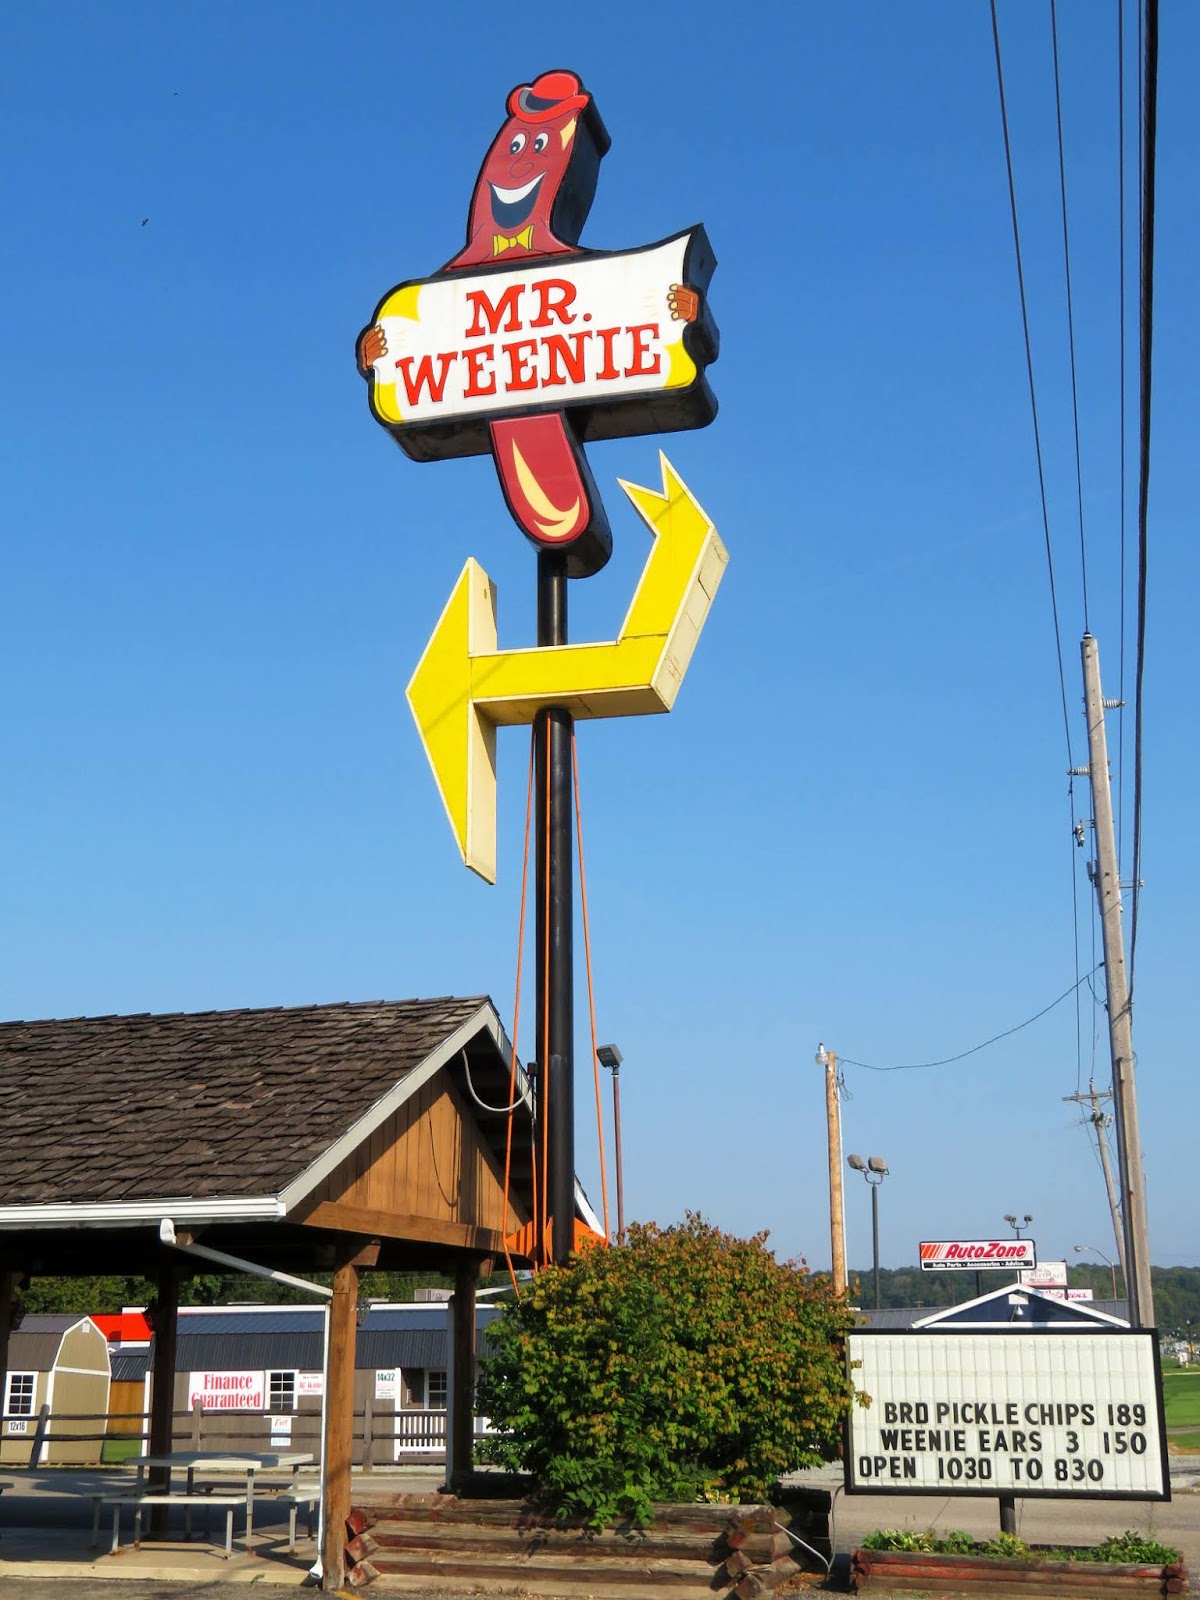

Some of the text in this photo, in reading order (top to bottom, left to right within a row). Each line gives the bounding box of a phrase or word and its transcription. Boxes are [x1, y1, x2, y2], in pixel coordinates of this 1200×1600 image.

[465, 278, 592, 338] MR.
[395, 323, 661, 406] WEENIE
[945, 1243, 1027, 1259] AutoZone
[203, 1374, 253, 1390] Finance
[377, 1372, 395, 1381] 14x32
[10, 1421, 25, 1431] 12x16
[885, 1402, 1147, 1426] BRD PICKLE CHIPS 189
[880, 1429, 1147, 1455] WEENIE EARS 3 150
[859, 1456, 1104, 1482] OPEN 1030 TO 830
